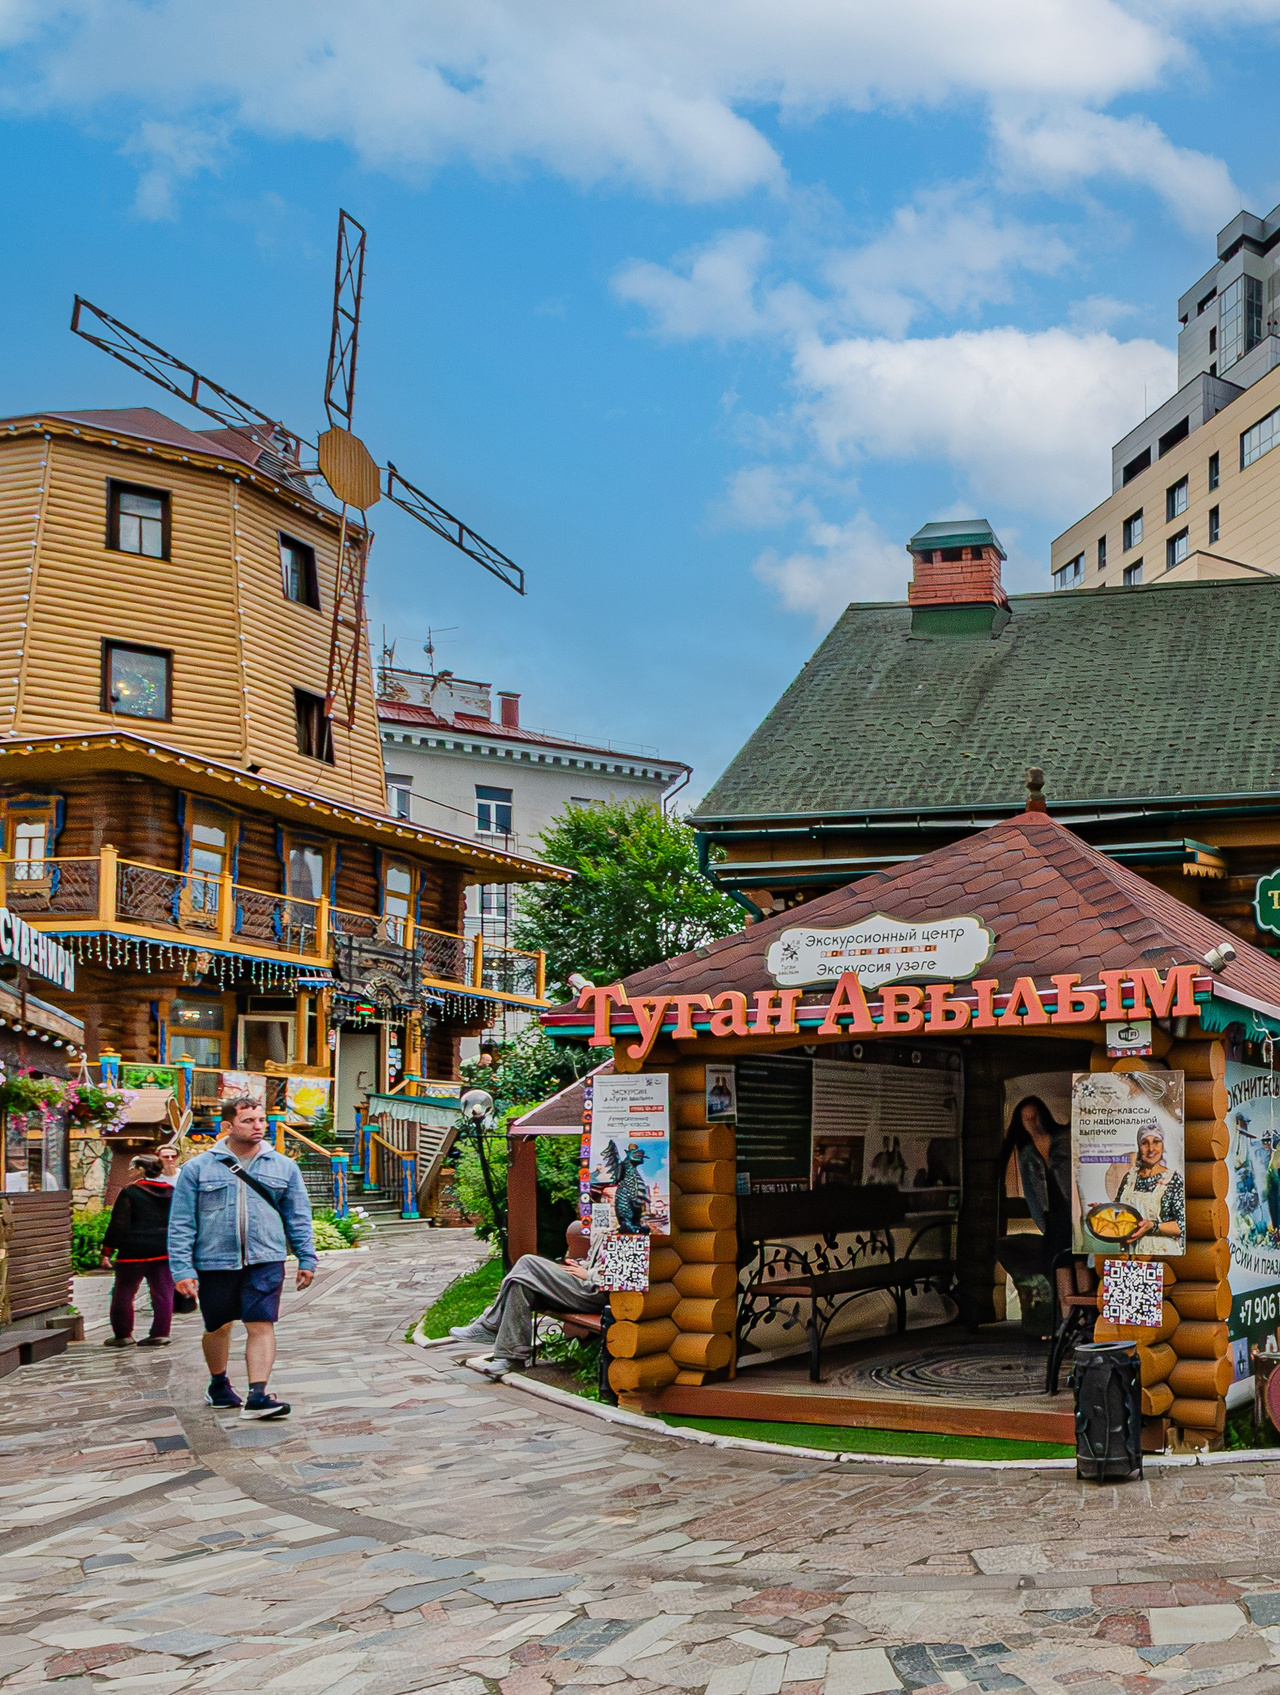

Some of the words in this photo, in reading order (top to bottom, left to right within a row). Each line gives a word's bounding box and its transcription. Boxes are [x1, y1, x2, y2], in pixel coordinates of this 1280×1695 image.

[805, 928, 917, 948] Экскурсионный
[921, 927, 965, 943] центр
[0, 907, 75, 992] СУВЕНИРЫ
[816, 963, 891, 976] Экскурсия
[895, 960, 937, 976] узәге
[577, 983, 802, 1059] Туган
[1079, 1107, 1151, 1116] Мастер-классы
[1093, 1116, 1158, 1126] национальной
[1079, 1128, 1118, 1136] выпечке
[1254, 1255, 1260, 1273] И
[1239, 1299, 1252, 1326] +7
[1254, 1293, 1276, 1323] 906
